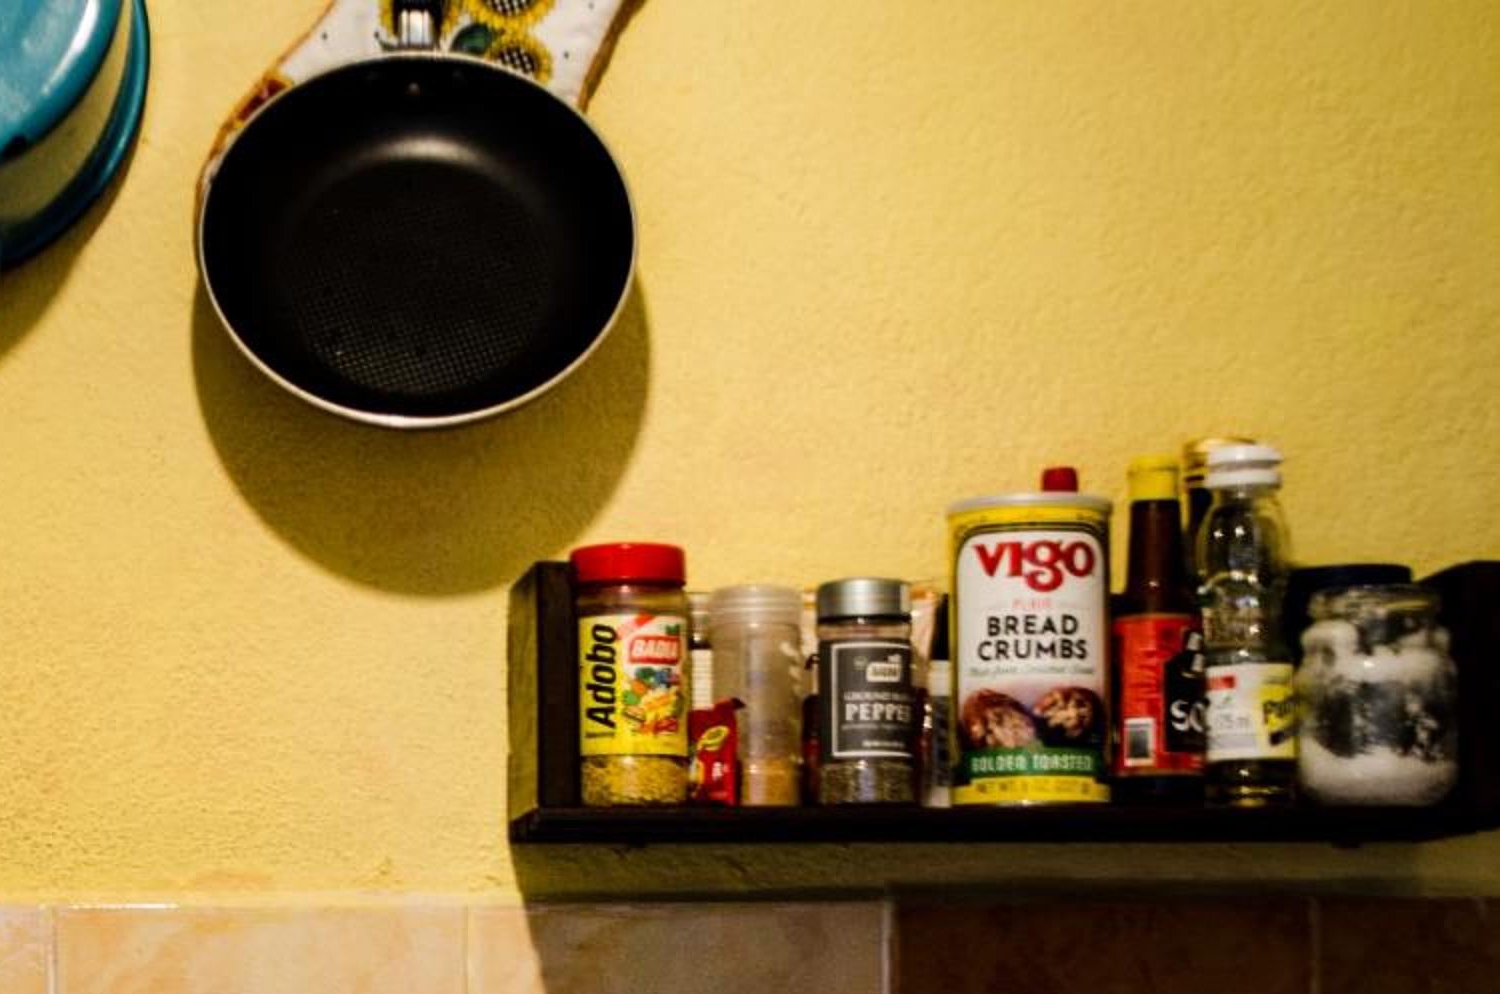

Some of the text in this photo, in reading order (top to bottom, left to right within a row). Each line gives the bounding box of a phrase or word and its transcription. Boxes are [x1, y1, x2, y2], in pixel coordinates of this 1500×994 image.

[987, 613, 1079, 637] BREAD
[977, 638, 1088, 661] CRUMBS
[586, 623, 618, 729] Adobo
[845, 702, 911, 722] PEPPE
[971, 755, 1028, 773] GOLDEN
[1032, 753, 1093, 771] TOASTED
